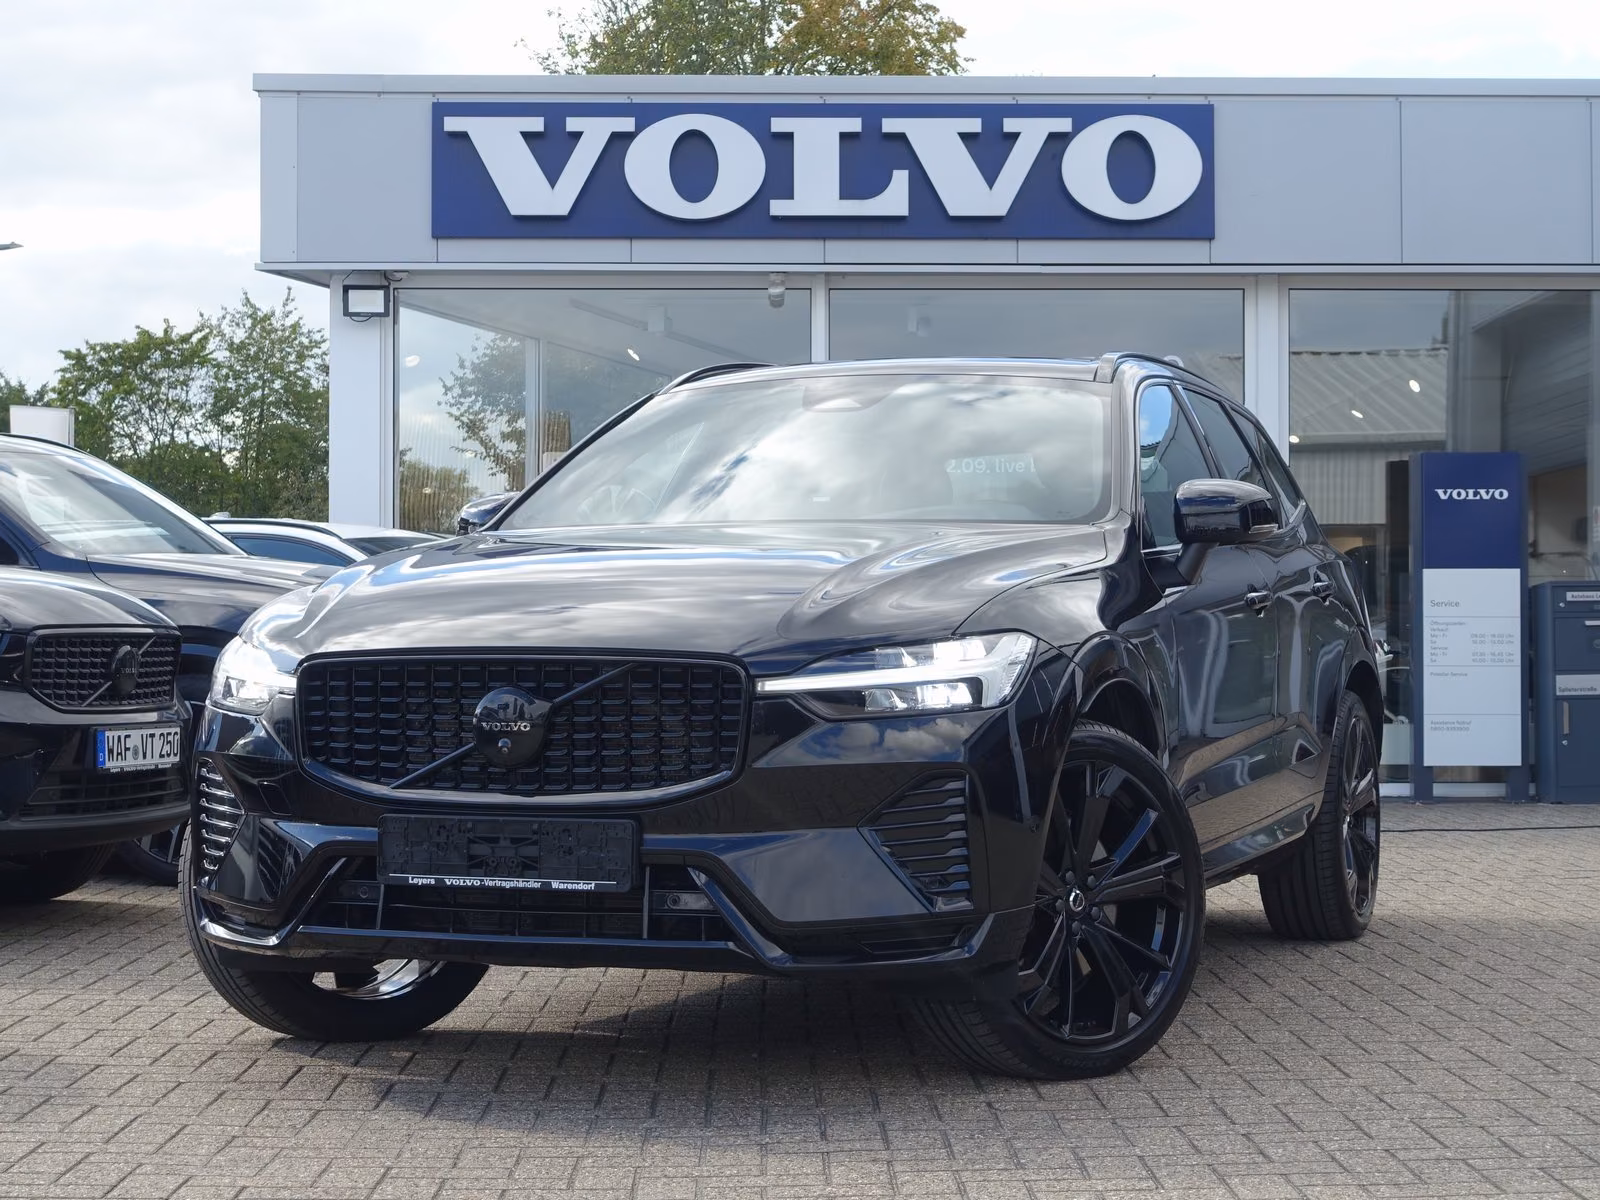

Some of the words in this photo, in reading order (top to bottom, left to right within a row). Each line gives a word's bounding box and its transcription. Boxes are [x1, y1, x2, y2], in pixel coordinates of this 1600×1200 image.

[443, 113, 1203, 221] VOLVO
[995, 458, 1025, 473] live
[1434, 488, 1509, 500] VOLVO
[1430, 600, 1460, 608] Service
[481, 722, 531, 731] VOLVO
[106, 734, 132, 762] WAF
[141, 732, 156, 760] VT
[158, 731, 179, 758] 250
[99, 753, 104, 761] D
[408, 876, 436, 886] Leyers
[551, 880, 595, 891] Warendorf
